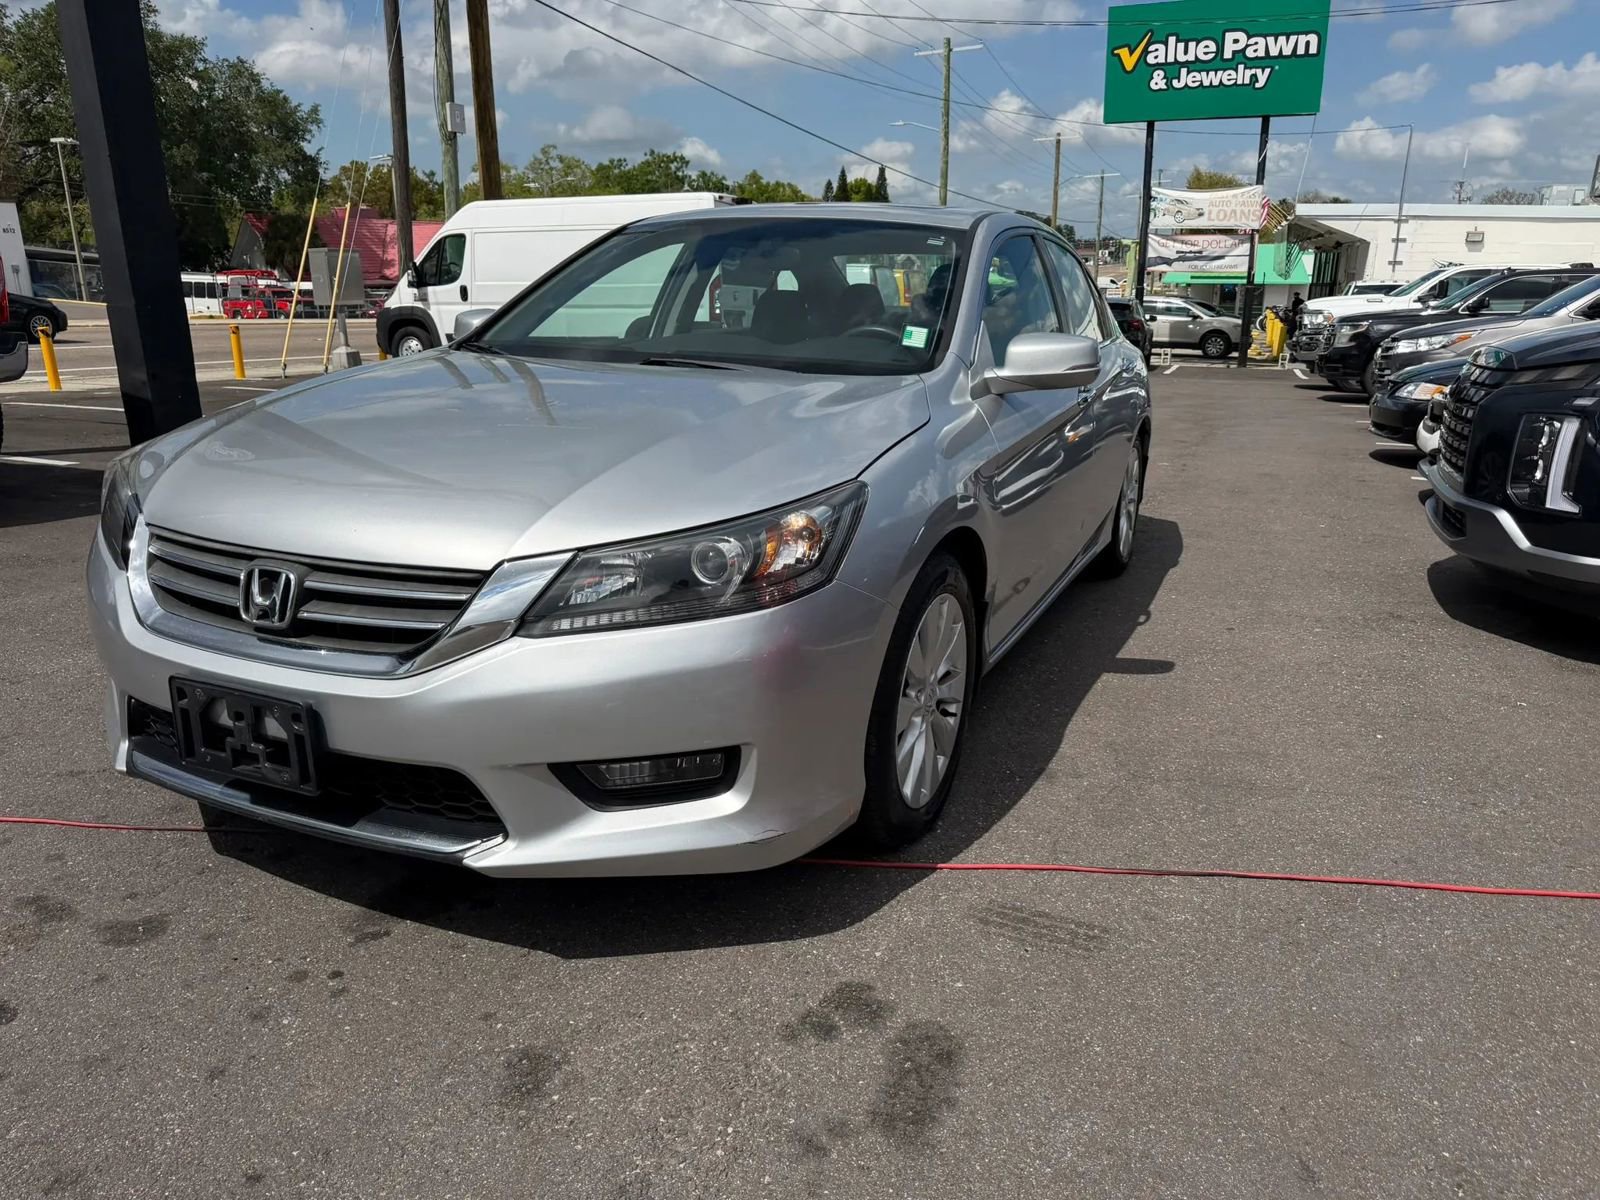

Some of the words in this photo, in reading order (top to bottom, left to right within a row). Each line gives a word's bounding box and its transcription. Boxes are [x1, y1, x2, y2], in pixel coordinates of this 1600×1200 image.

[1113, 31, 1216, 72] Value
[1223, 32, 1319, 59] Pawn
[1150, 70, 1167, 90] &
[1172, 64, 1271, 89] Jewelry
[1208, 199, 1232, 208] AUTO
[1234, 199, 1262, 208] PAWN
[1207, 208, 1261, 222] LOANS
[1157, 239, 1175, 248] GET
[1180, 239, 1200, 249] TOP
[1201, 238, 1244, 249] DOLLAR
